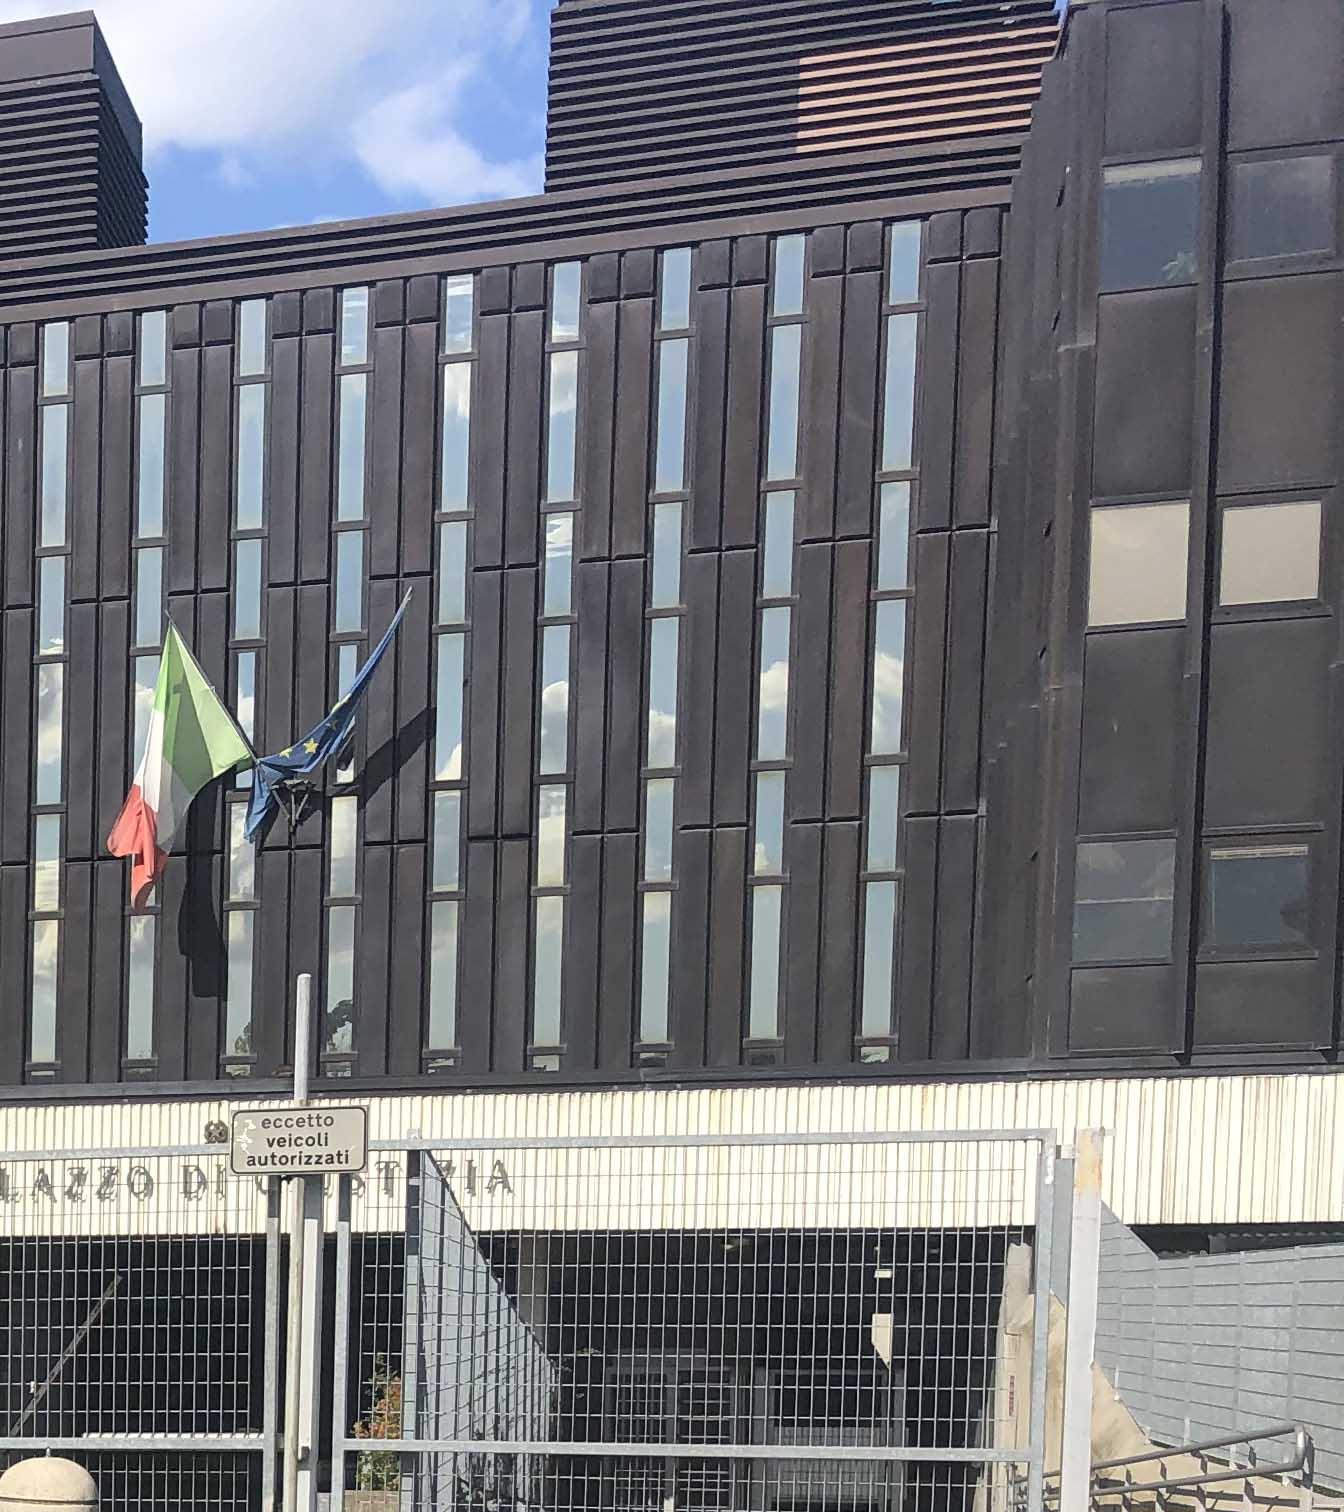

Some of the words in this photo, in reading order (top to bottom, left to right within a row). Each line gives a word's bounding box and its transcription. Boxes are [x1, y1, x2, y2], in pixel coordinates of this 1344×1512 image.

[261, 1113, 335, 1129] eccetto
[266, 1132, 329, 1148] veicoli
[246, 1149, 350, 1167] autorizzati
